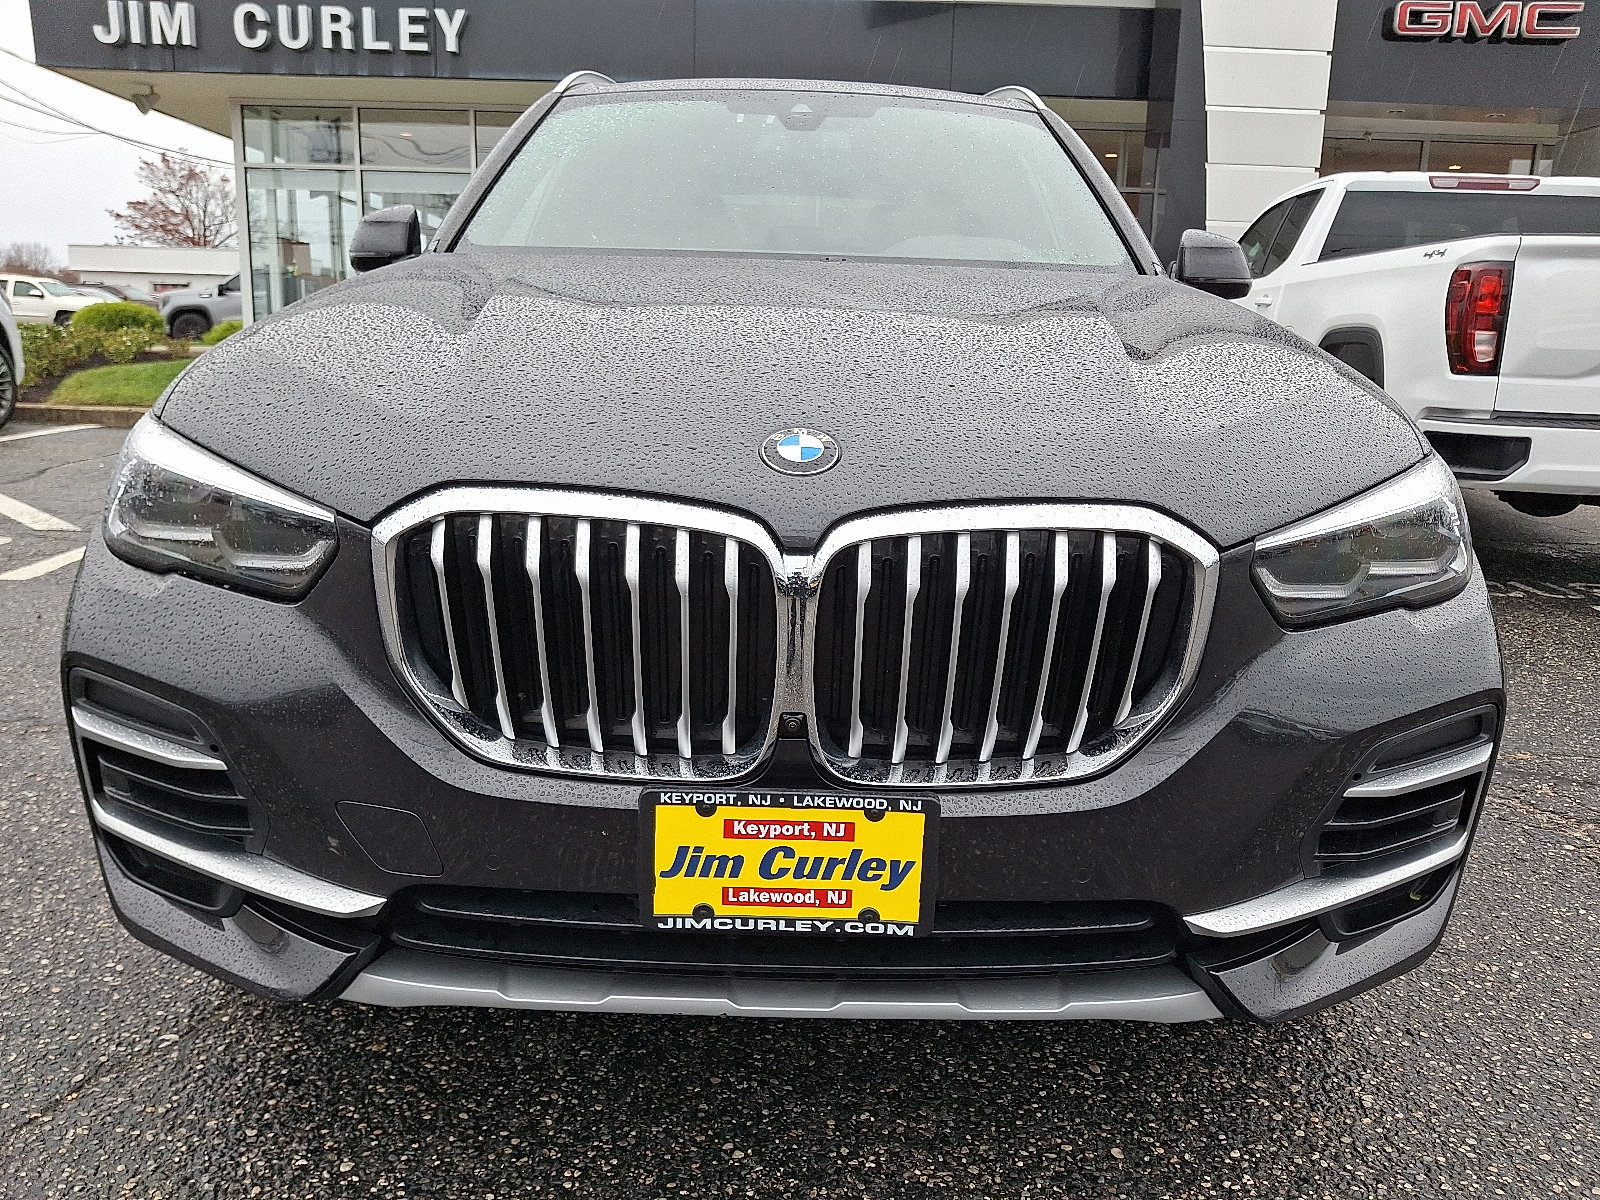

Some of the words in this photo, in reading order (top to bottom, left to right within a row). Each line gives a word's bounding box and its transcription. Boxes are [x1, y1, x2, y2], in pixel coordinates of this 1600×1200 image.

[92, 0, 198, 48] JIM
[233, 3, 466, 54] CURLEY
[1394, 1, 1585, 39] GMC
[660, 792, 741, 806] KEYPORT,
[748, 795, 772, 806] NJ
[793, 796, 892, 811] LAKEWOOD,
[899, 800, 923, 811] NJ
[733, 821, 816, 839] Keyport,
[823, 824, 846, 837] NJ
[659, 846, 745, 879] Jim
[758, 846, 916, 891] Curley
[728, 889, 820, 906] Lakewood,
[827, 891, 847, 905] NJ
[657, 917, 915, 937] JIMCURLEY.COM
